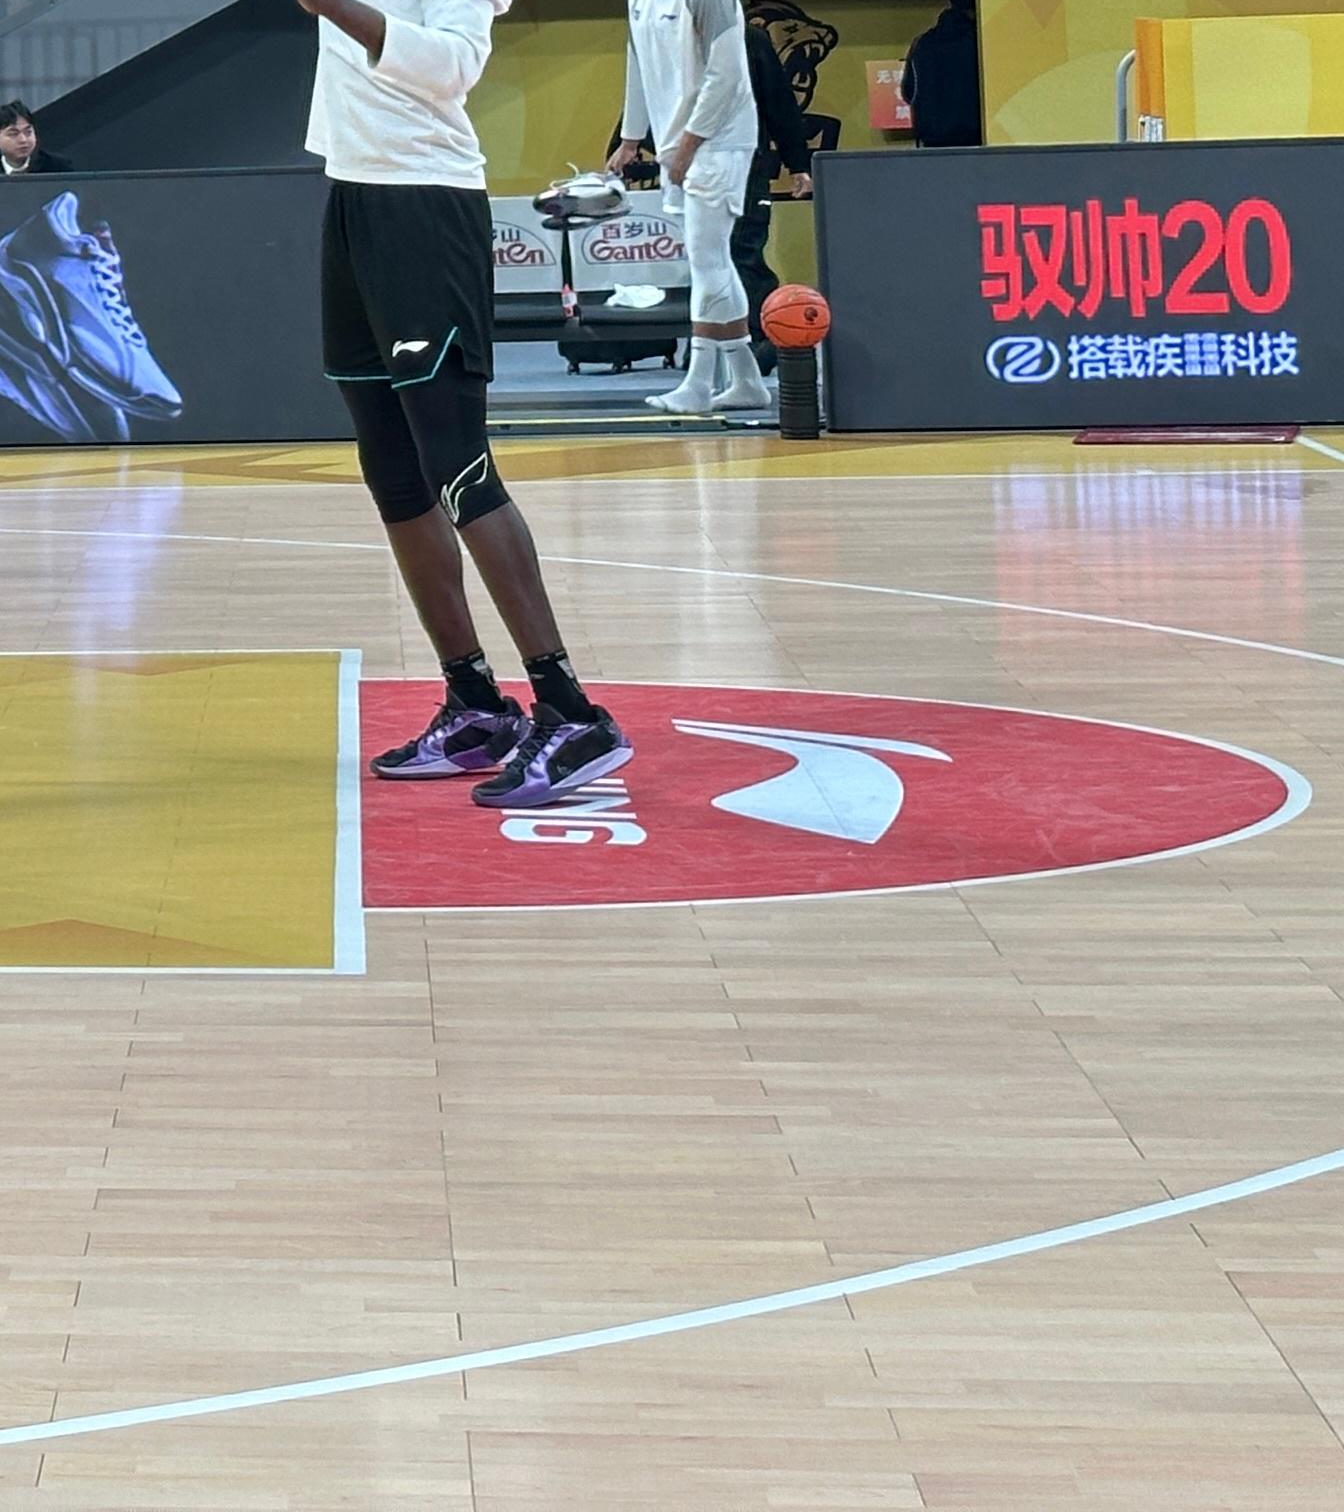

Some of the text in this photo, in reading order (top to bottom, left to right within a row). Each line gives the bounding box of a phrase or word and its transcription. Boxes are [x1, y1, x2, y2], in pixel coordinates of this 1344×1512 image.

[602, 222, 667, 240] 百岁山
[976, 197, 1291, 322] 驭帅20
